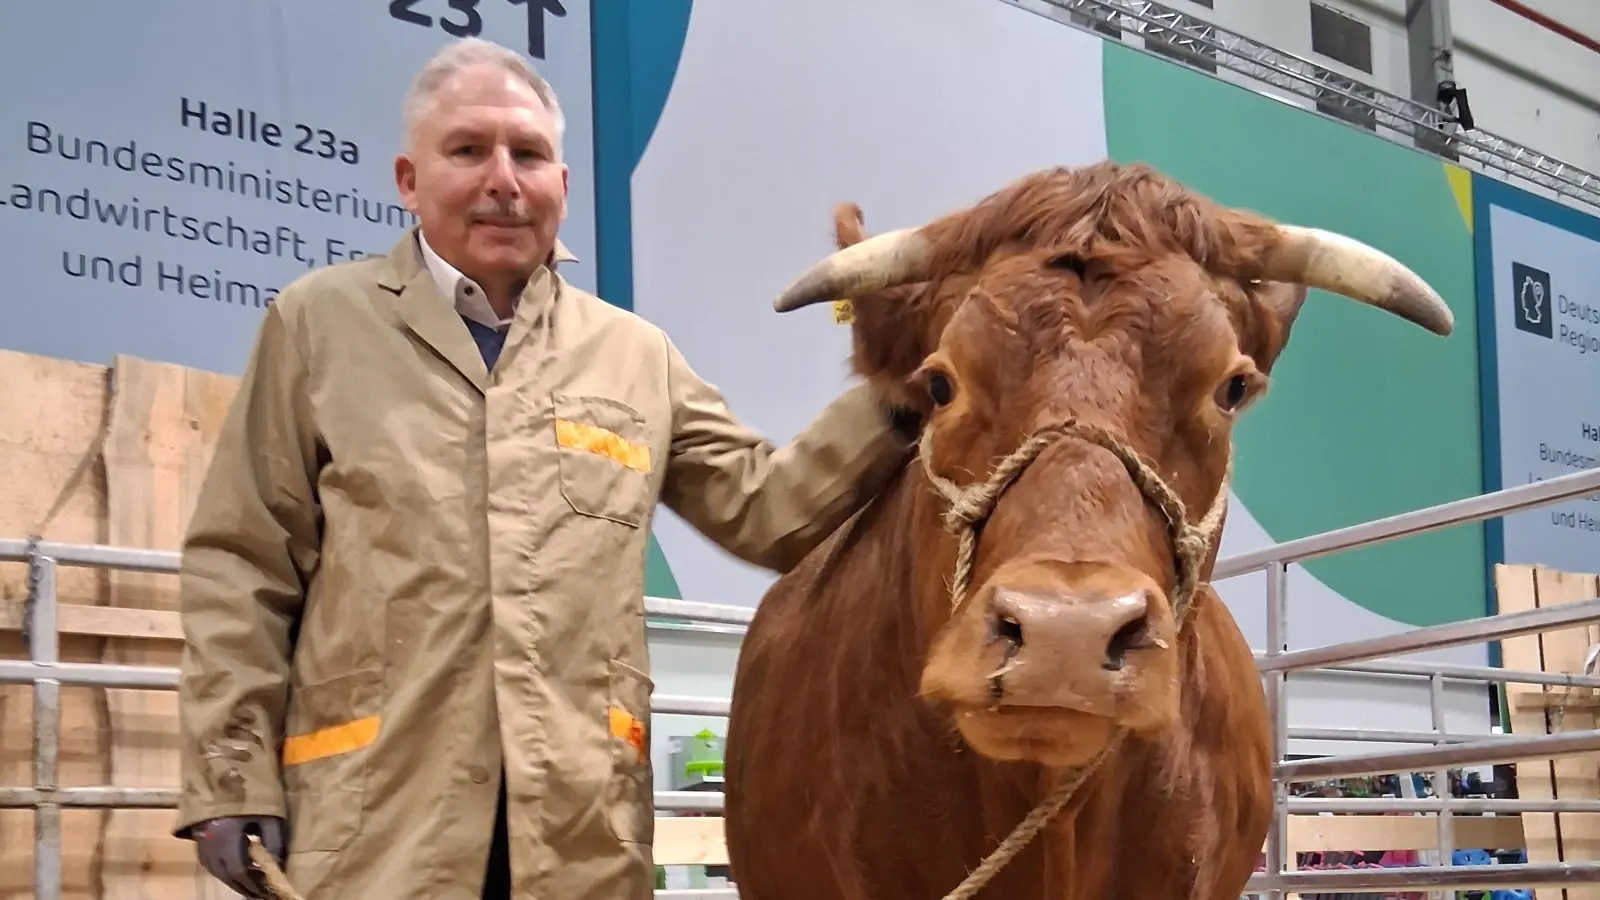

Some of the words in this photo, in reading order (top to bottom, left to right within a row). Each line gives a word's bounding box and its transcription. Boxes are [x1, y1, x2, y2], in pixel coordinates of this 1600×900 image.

[180, 97, 282, 148] Halle
[294, 124, 359, 165] 23a
[27, 121, 416, 229] Bundesministerium
[0, 186, 315, 268] andwirtschaft,
[62, 251, 142, 287] und
[1552, 511, 1576, 528] und
